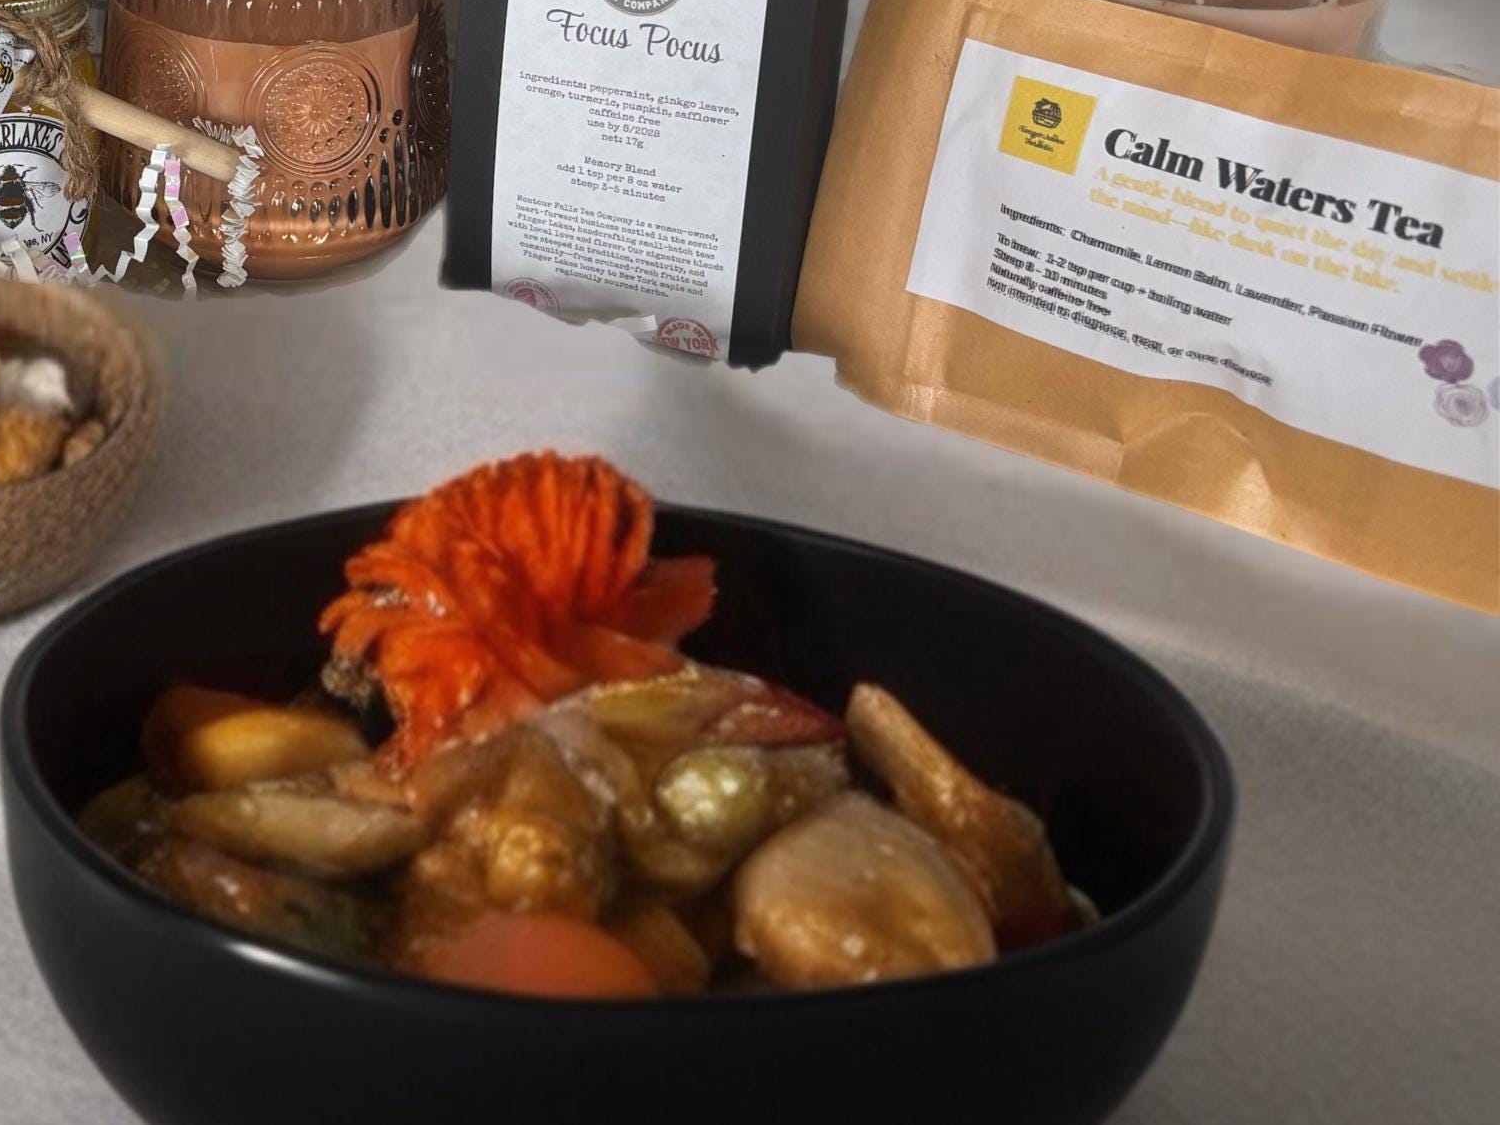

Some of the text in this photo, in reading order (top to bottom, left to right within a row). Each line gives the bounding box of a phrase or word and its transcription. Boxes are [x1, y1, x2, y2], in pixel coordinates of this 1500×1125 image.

[546, 8, 724, 64] Focus Pocus
[519, 70, 740, 117] ingredients: peppermint, ginkgo leaves,
[525, 84, 730, 126] orange, turmeric, pumpkin, safflower
[587, 119, 606, 129] use
[607, 121, 621, 133] by
[588, 108, 661, 127] caffeine free
[601, 133, 644, 149] net: 17g
[556, 163, 576, 174] add
[586, 168, 604, 181] tsp
[606, 173, 626, 183] per
[635, 179, 649, 188] oz
[651, 182, 683, 194] water
[583, 155, 656, 177] Memory Blend
[570, 177, 666, 203] steep 3-5 minutes
[1104, 128, 1204, 182] Calm
[1216, 156, 1357, 224] Waters
[1367, 198, 1444, 249] Tea
